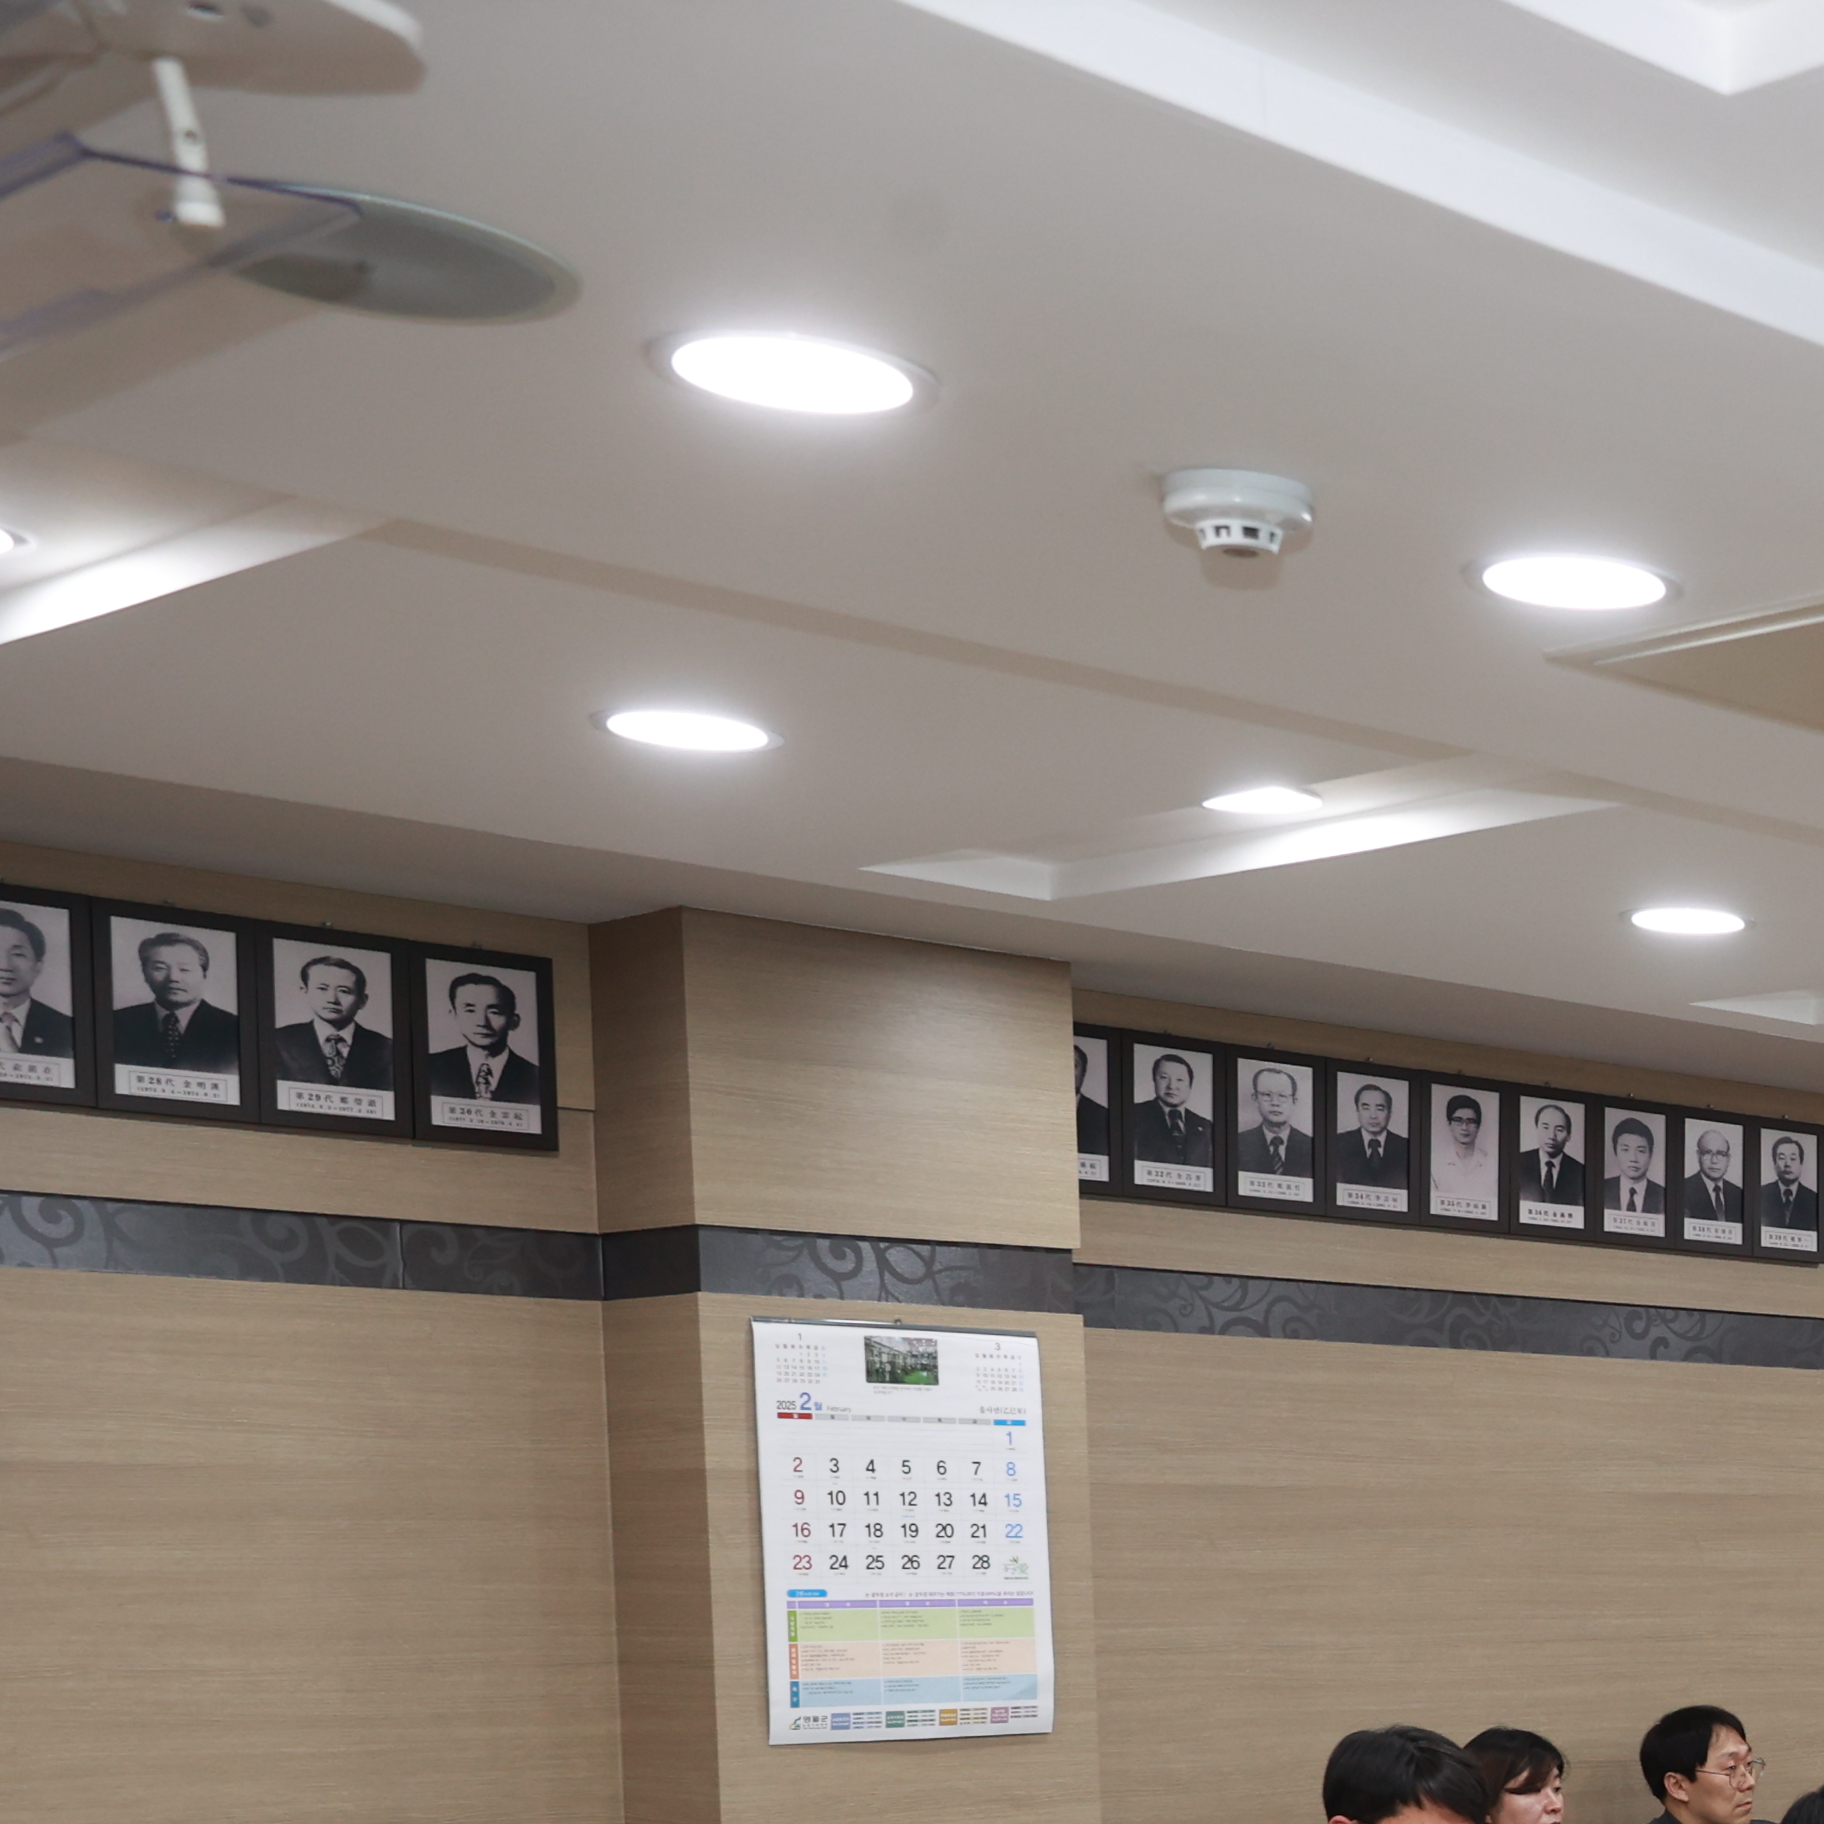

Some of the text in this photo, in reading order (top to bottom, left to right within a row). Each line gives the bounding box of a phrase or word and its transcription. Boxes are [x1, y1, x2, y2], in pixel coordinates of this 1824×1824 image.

[994, 1342, 1001, 1351] 3
[776, 1400, 797, 1411] 2025
[1006, 1431, 1013, 1445] 1
[793, 1456, 1017, 1477] 2 3 4 5 6 7 8
[794, 1489, 1023, 1508] 9 10 11 12 13 14 15
[792, 1522, 1023, 1539] 16 17 18 19 20 21 22
[793, 1554, 991, 1571] 23 24 25 26 27 28
